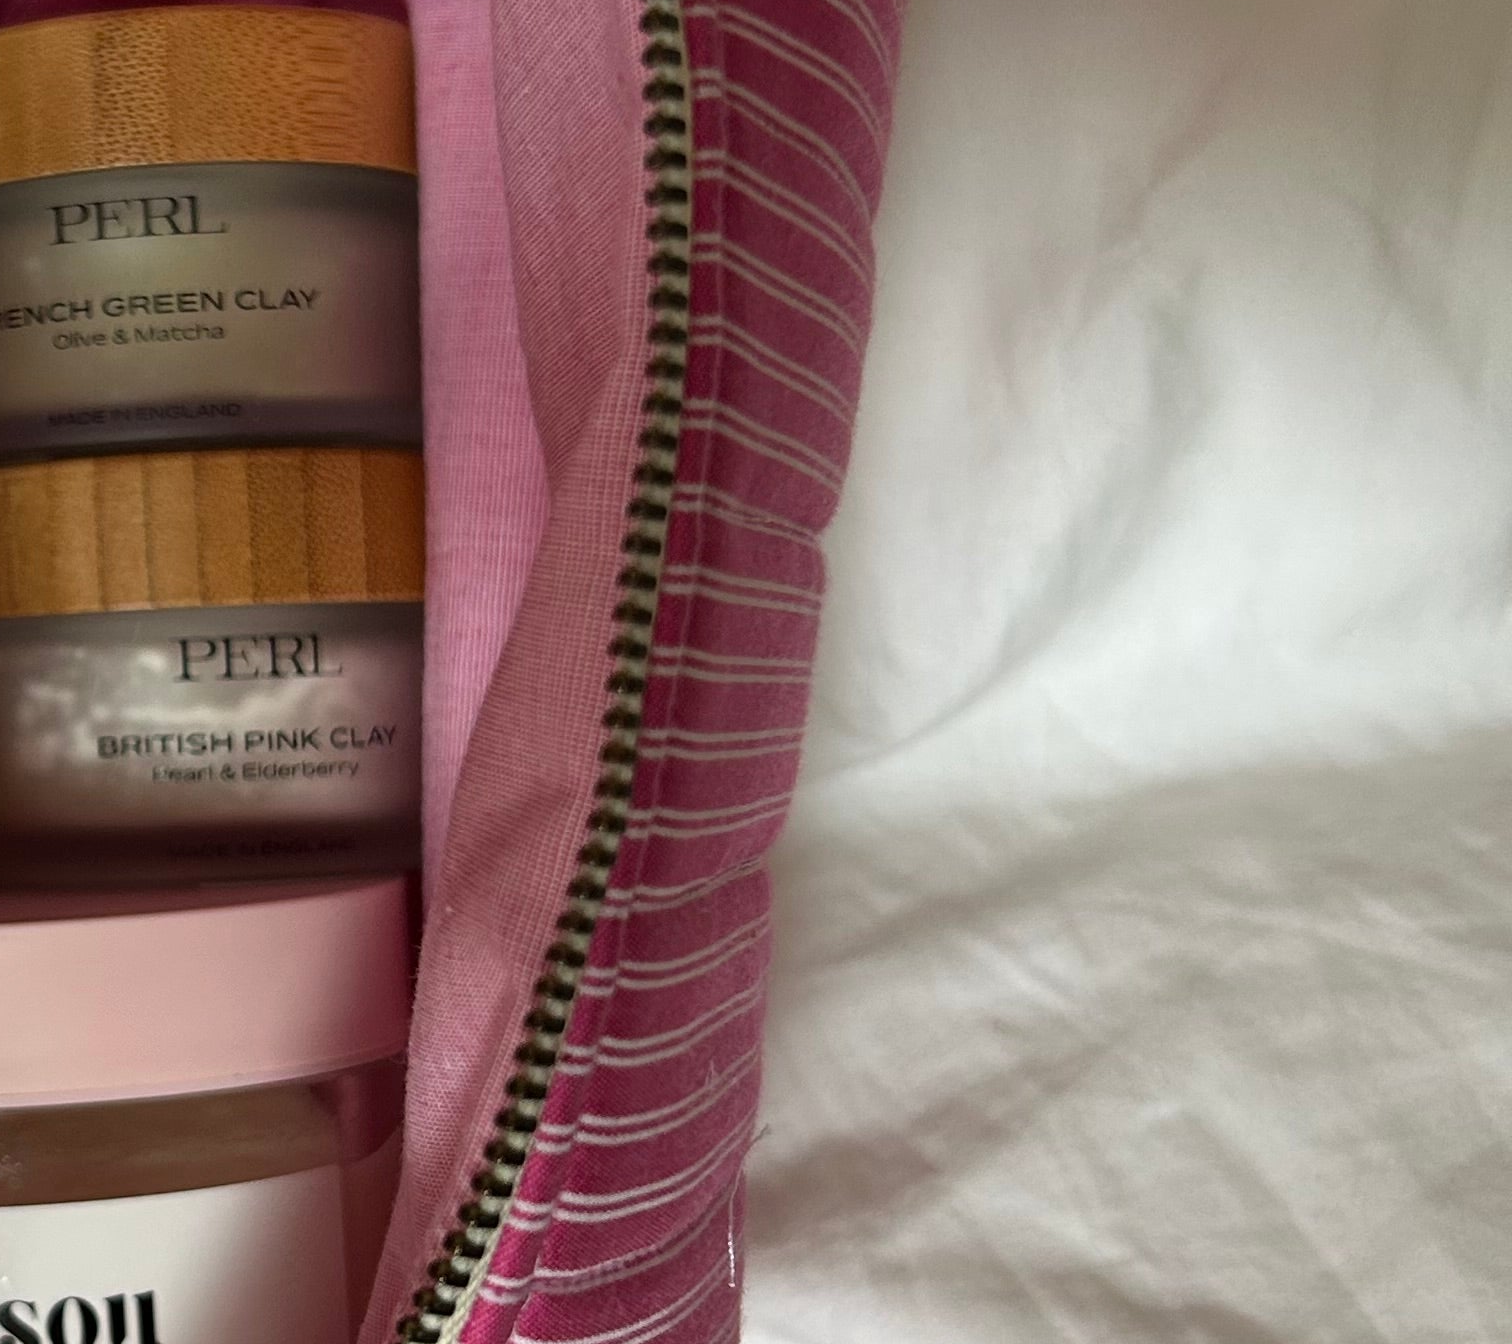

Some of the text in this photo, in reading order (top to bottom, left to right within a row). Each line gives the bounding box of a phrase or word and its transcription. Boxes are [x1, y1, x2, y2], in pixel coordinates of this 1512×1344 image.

[47, 195, 228, 245] PERL
[102, 290, 224, 318] GREEN
[234, 288, 320, 311] CLAY
[51, 323, 226, 350] Olive & Matcha
[135, 402, 241, 422] ENGLAND
[170, 631, 344, 682] PERL
[97, 725, 396, 759] BRITISH PINK CLAY
[220, 762, 237, 781] &
[243, 759, 360, 780] Elderberry
